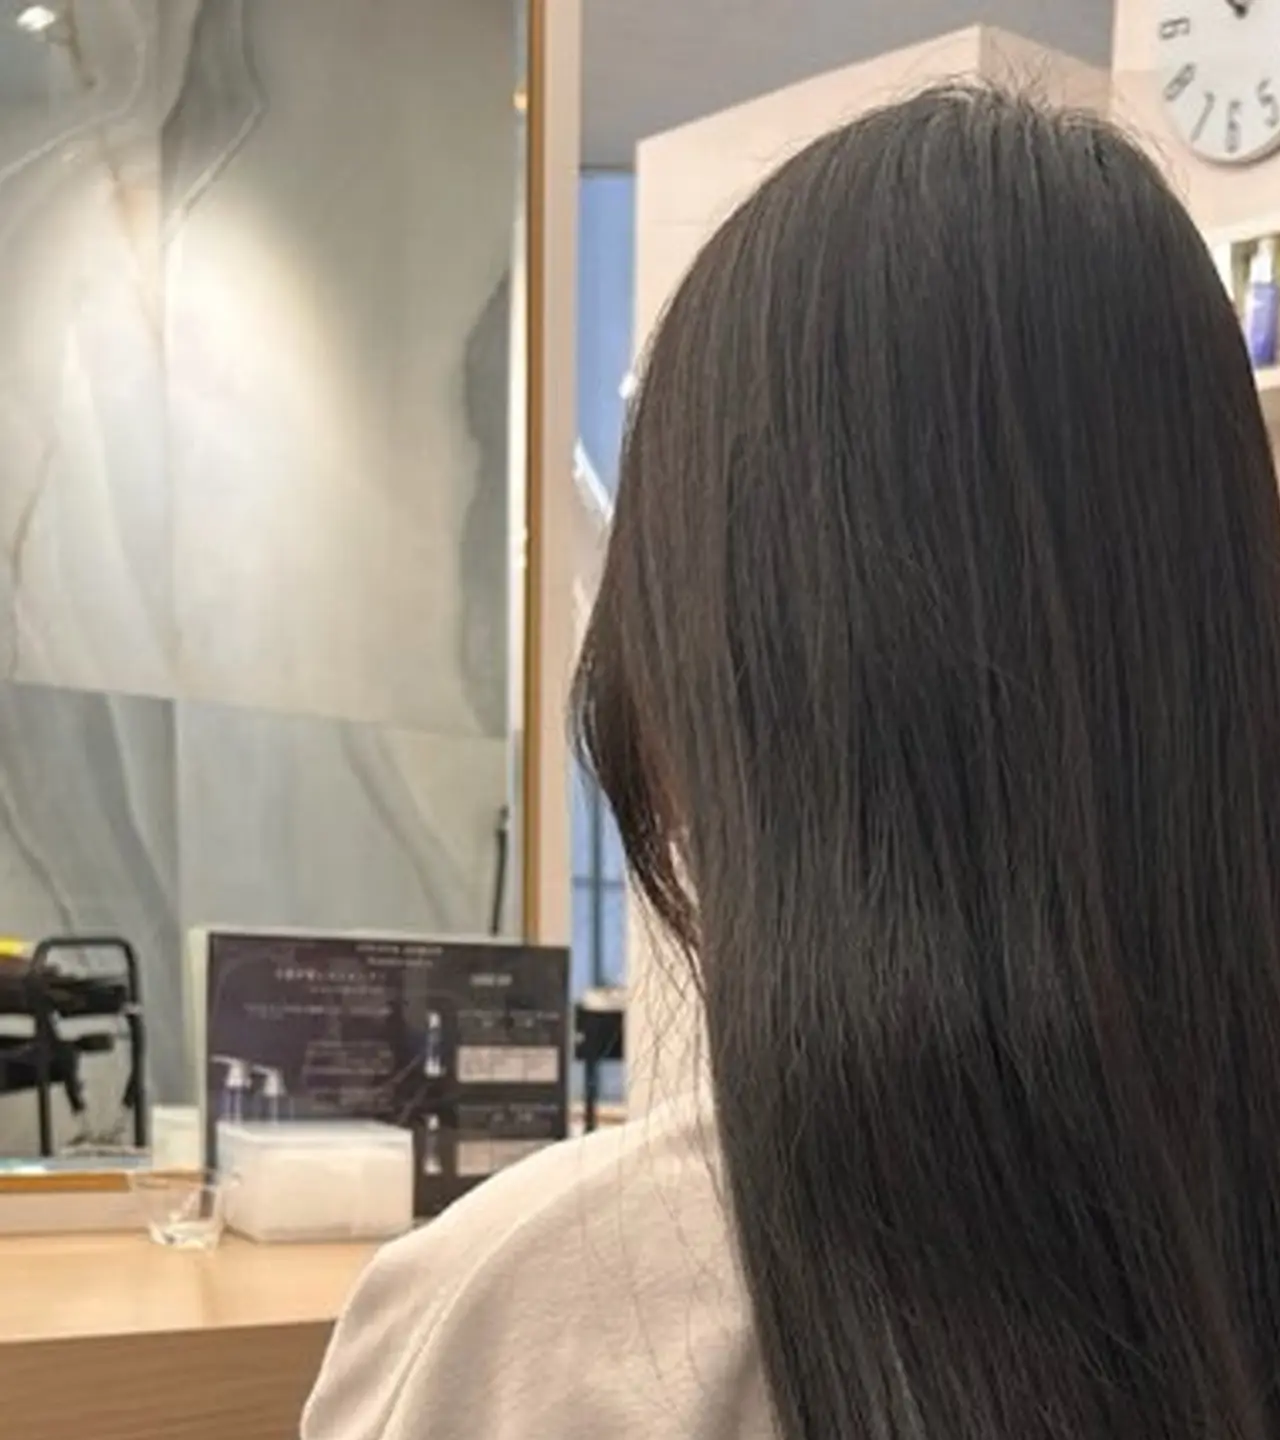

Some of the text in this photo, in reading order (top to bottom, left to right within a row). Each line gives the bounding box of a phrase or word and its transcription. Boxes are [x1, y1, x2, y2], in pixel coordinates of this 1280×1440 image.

[1159, 17, 1191, 40] 9
[1164, 61, 1197, 102] 8
[1257, 77, 1280, 129] 5
[1190, 91, 1215, 143] 7
[1225, 99, 1243, 154] 6
